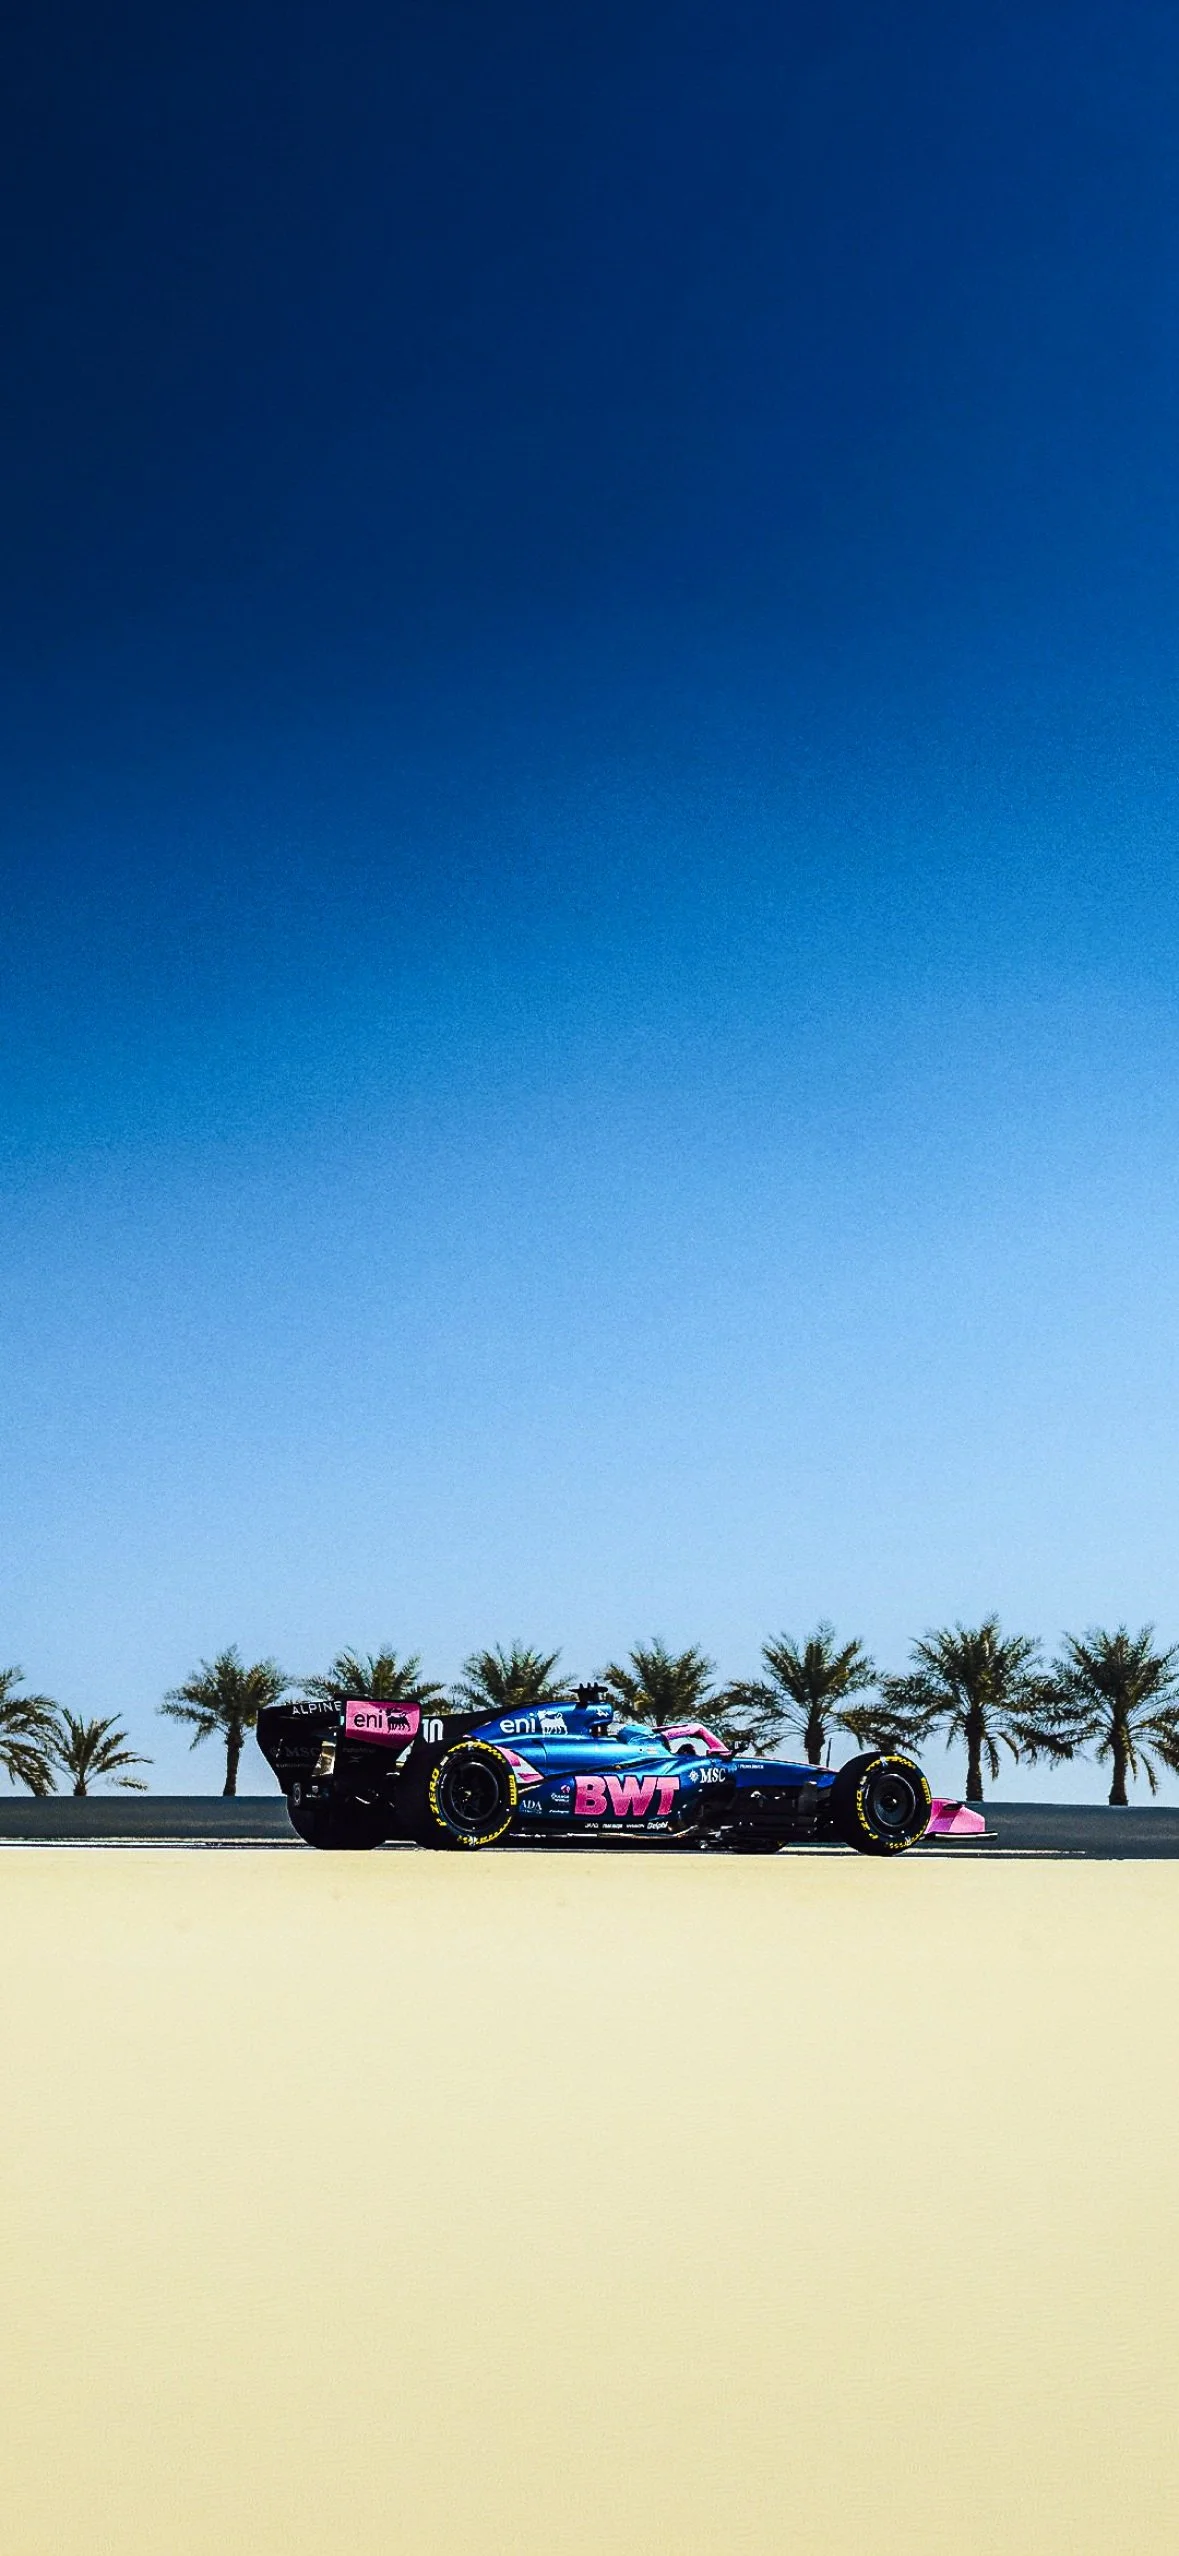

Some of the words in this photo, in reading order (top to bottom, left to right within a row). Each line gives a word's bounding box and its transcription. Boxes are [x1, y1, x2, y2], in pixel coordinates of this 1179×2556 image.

[292, 1701, 342, 1715] ALPINE
[354, 1709, 383, 1728] eni
[500, 1713, 535, 1734] eni
[421, 1718, 444, 1743] 10
[700, 1768, 726, 1783] MSC
[574, 1775, 680, 1816] BWT
